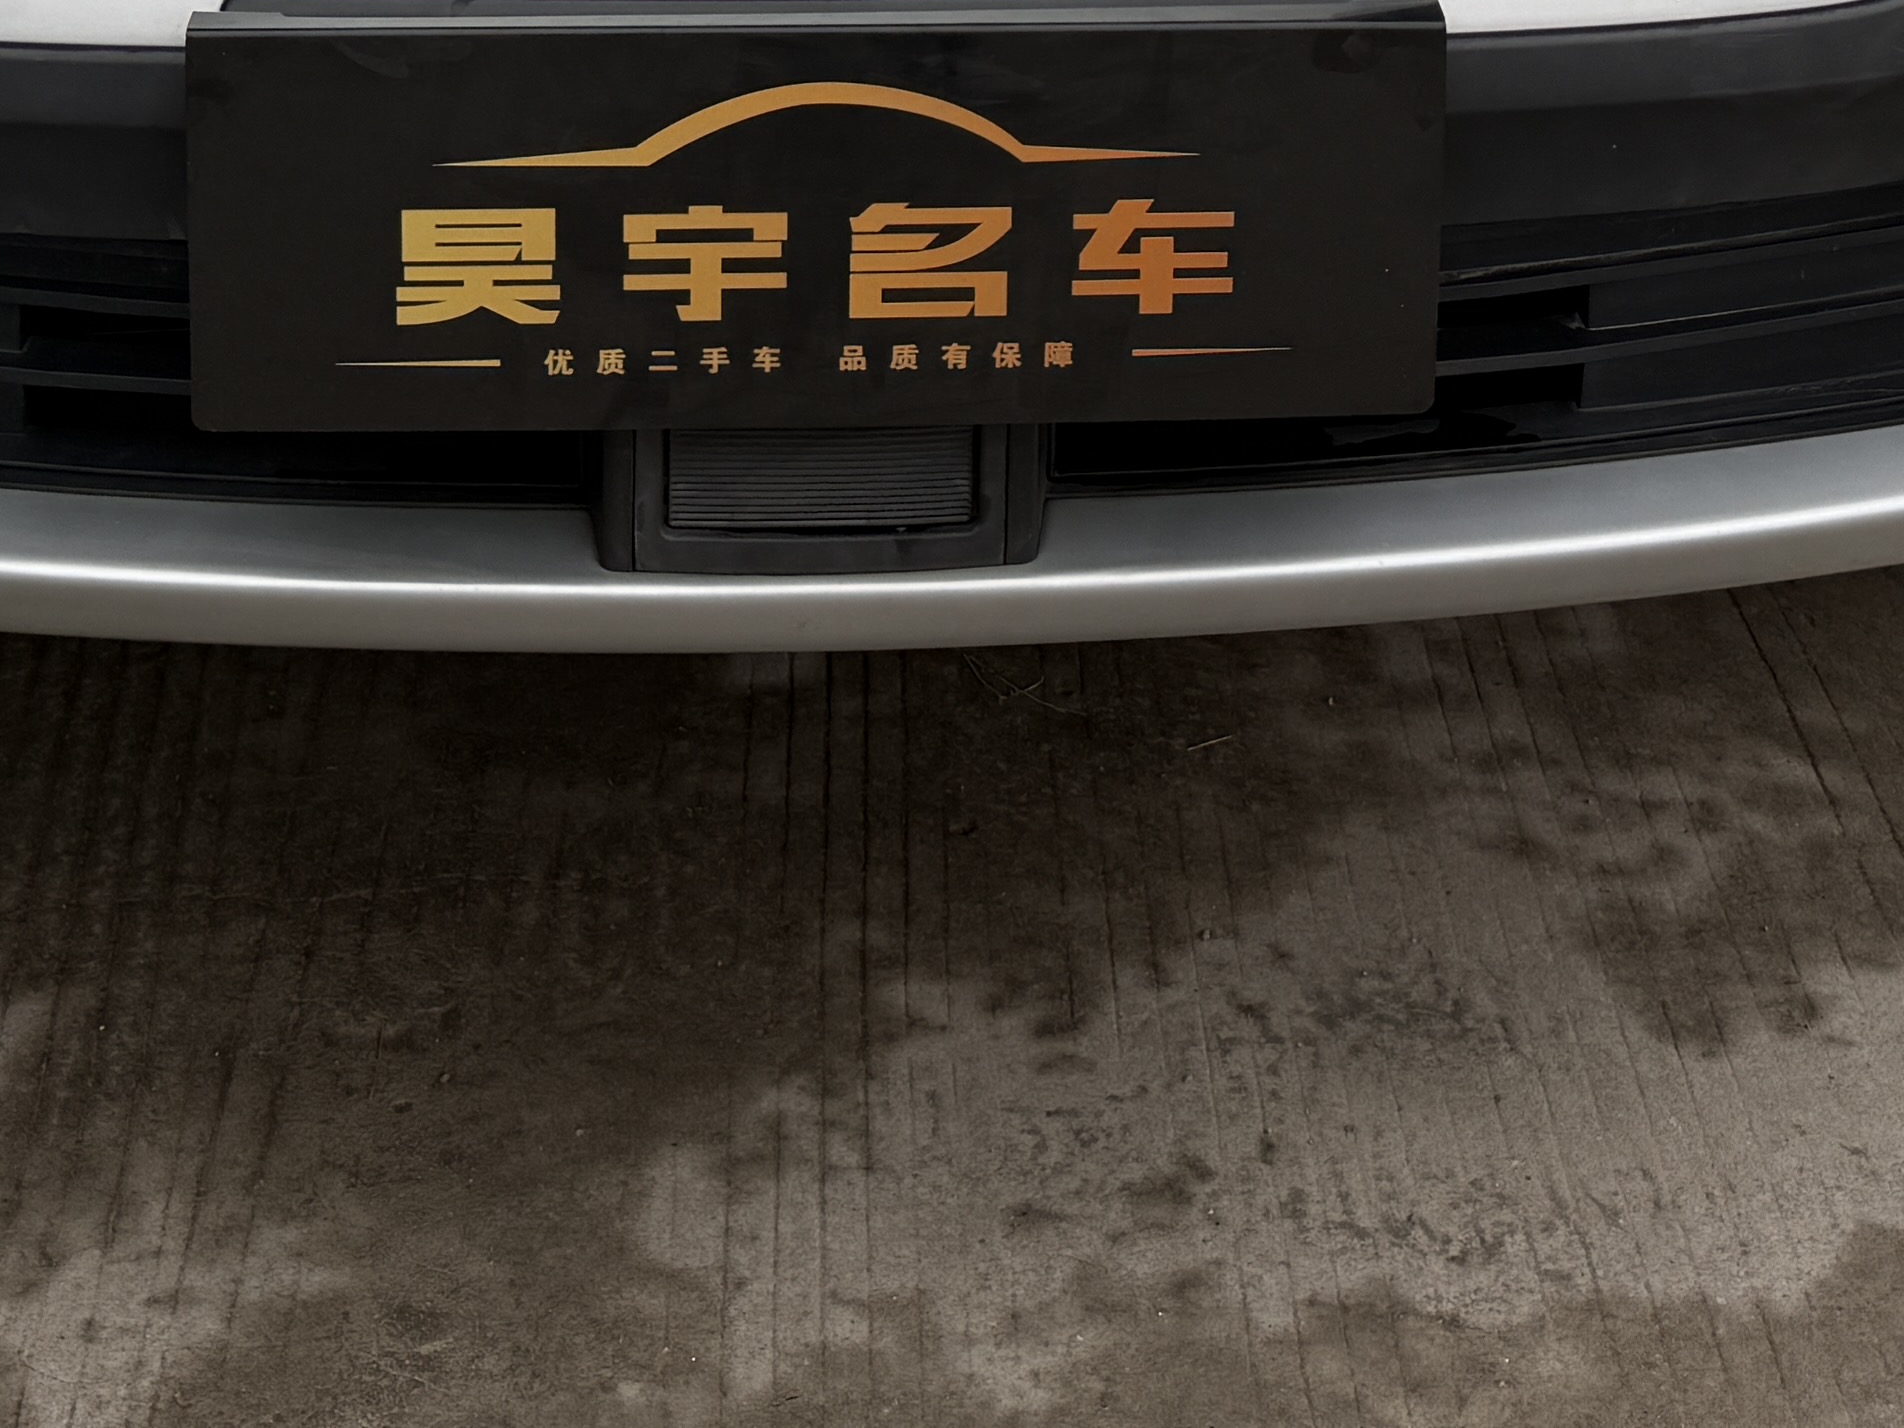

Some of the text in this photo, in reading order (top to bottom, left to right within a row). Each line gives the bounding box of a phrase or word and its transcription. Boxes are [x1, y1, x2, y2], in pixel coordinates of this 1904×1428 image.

[396, 200, 1234, 325] 昊宇名车
[544, 340, 1074, 376] 优质二手车 品质有保障
